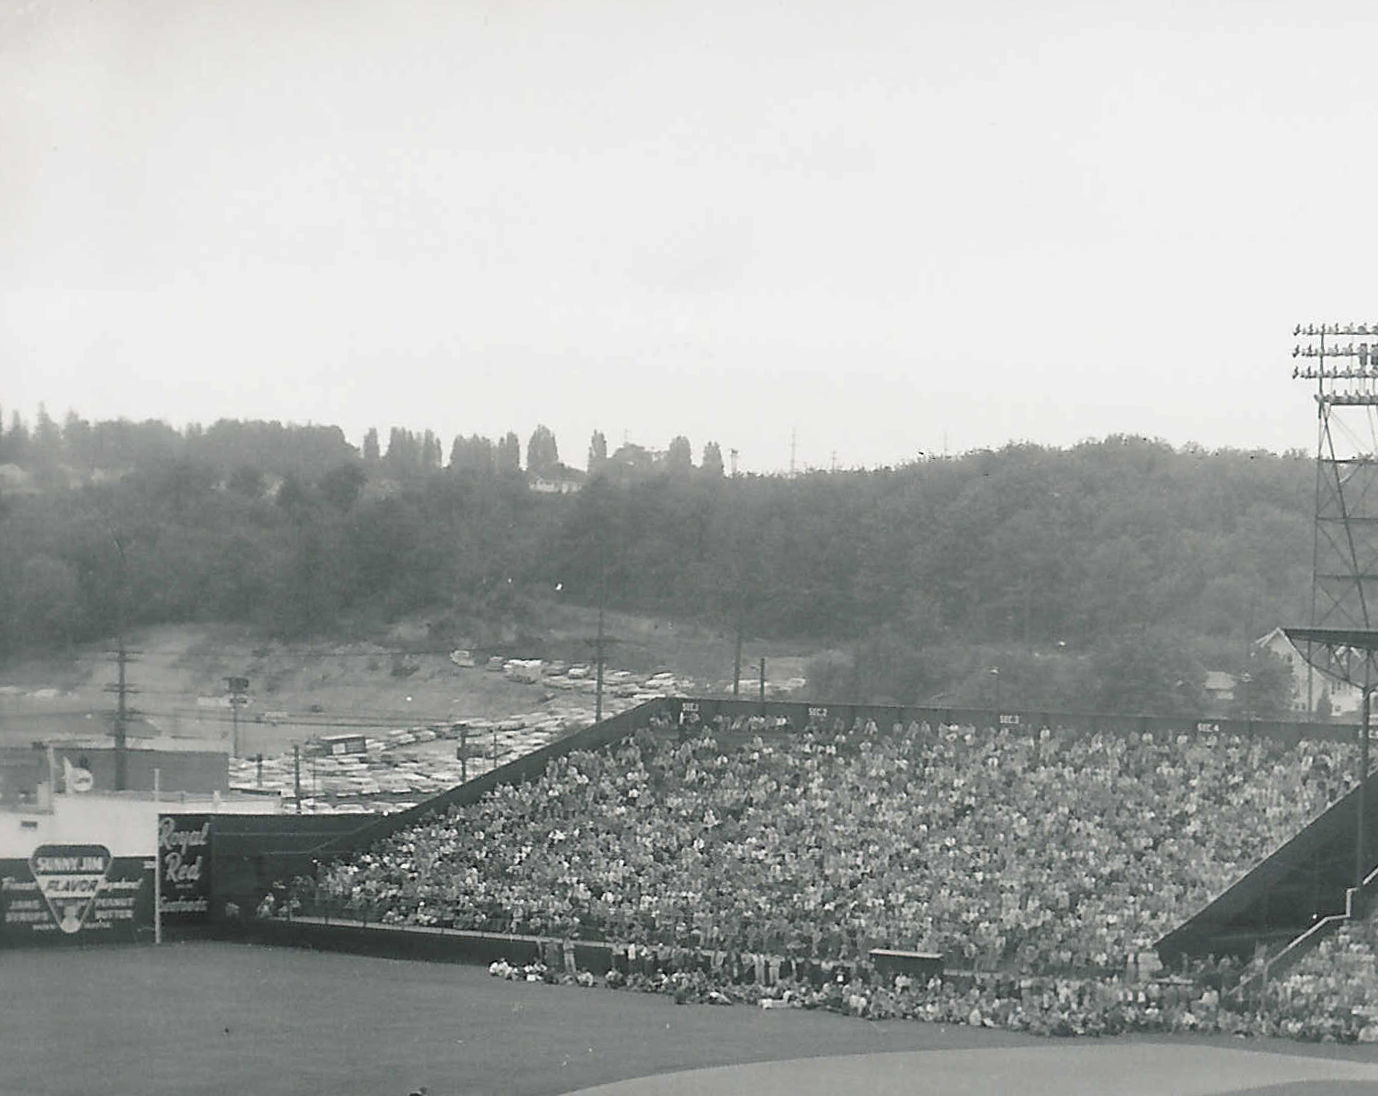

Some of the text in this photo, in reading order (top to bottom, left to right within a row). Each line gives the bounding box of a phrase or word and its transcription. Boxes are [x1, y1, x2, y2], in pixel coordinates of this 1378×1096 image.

[160, 817, 211, 855] Royal
[36, 857, 104, 872] SUNNY JIM
[165, 852, 203, 882] Red
[46, 880, 99, 892] FLAVOR
[95, 898, 136, 908] PEANUT
[95, 909, 134, 919] BUTTER
